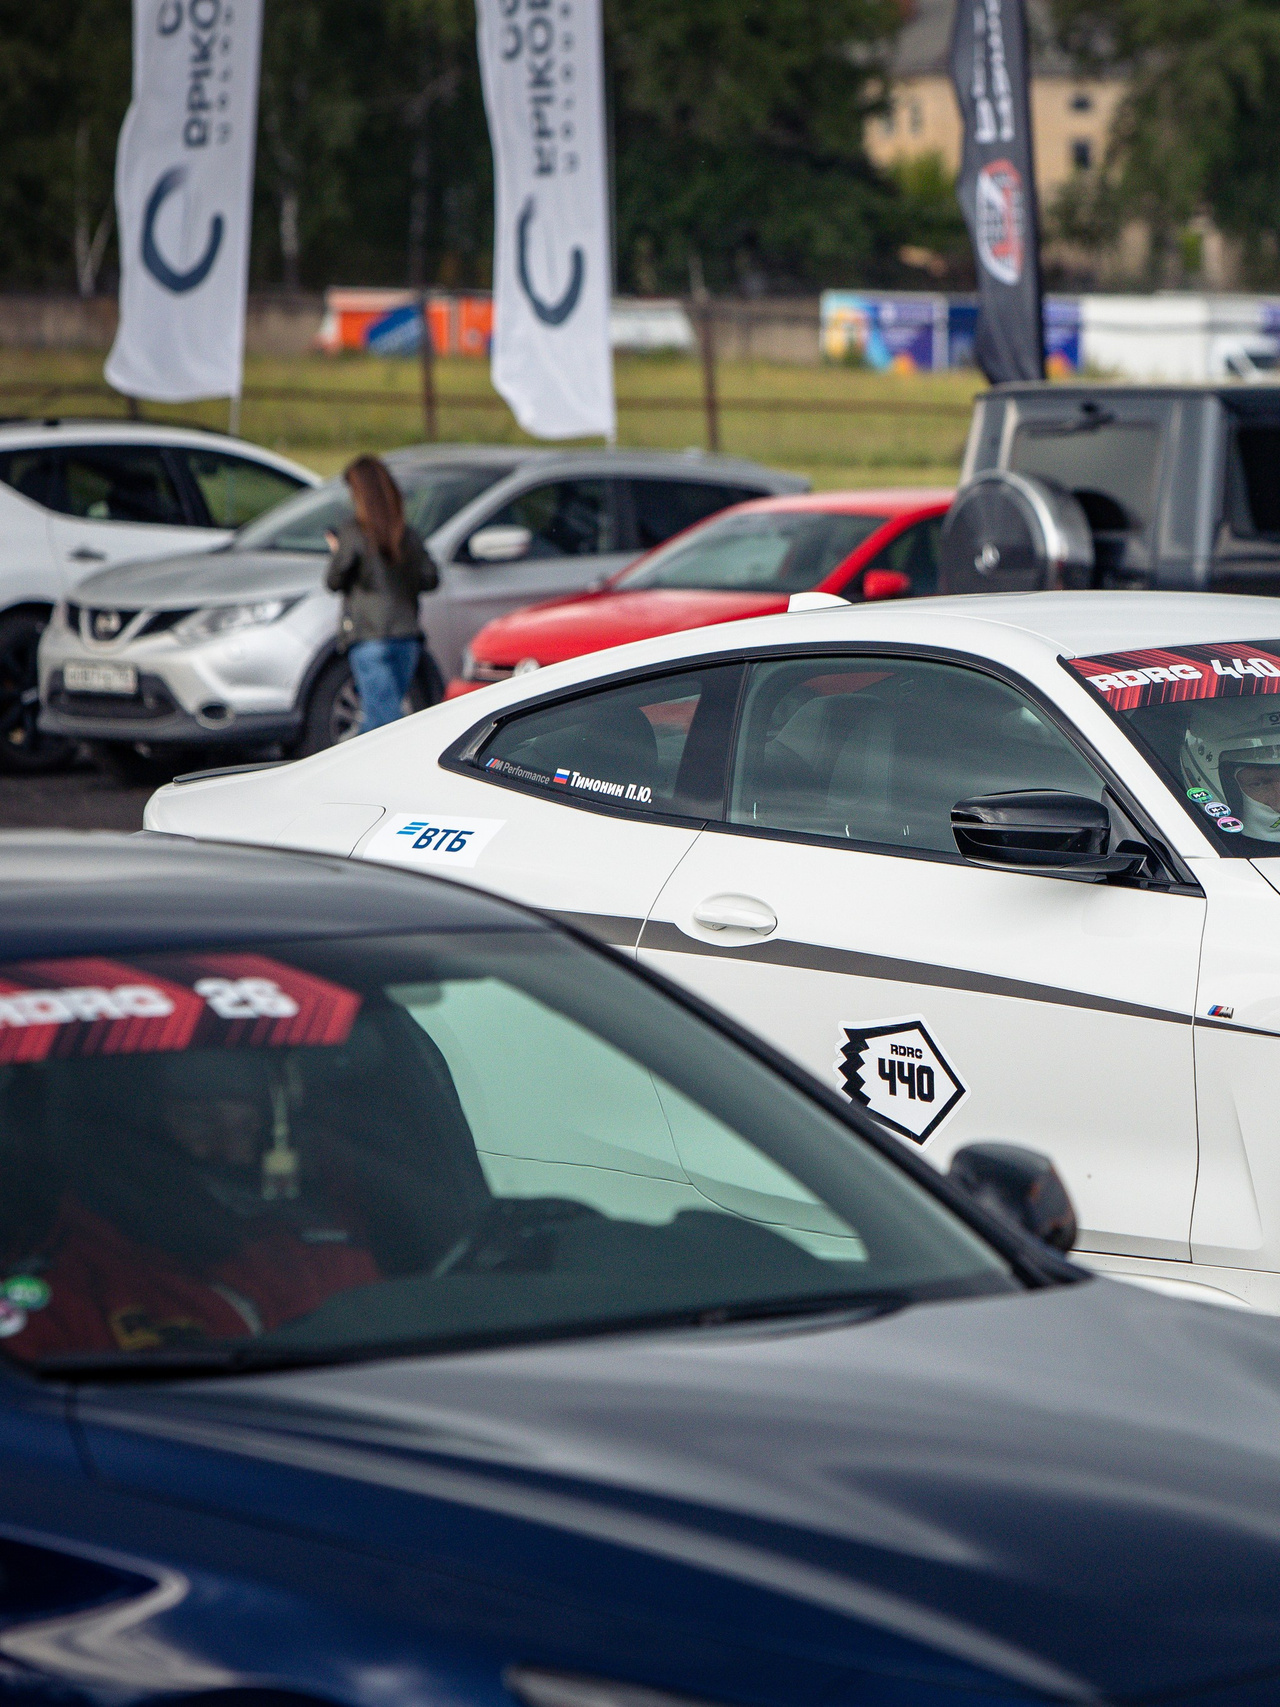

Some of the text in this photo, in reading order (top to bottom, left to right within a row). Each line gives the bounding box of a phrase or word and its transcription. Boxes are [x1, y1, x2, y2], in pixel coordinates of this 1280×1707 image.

[1086, 664, 1203, 692] RDRC
[503, 762, 550, 785] Performance
[570, 772, 653, 803] Тимонин П.Ю.
[412, 828, 475, 852] ВТБ
[890, 1044, 923, 1059] RDRC
[878, 1057, 935, 1103] 440
